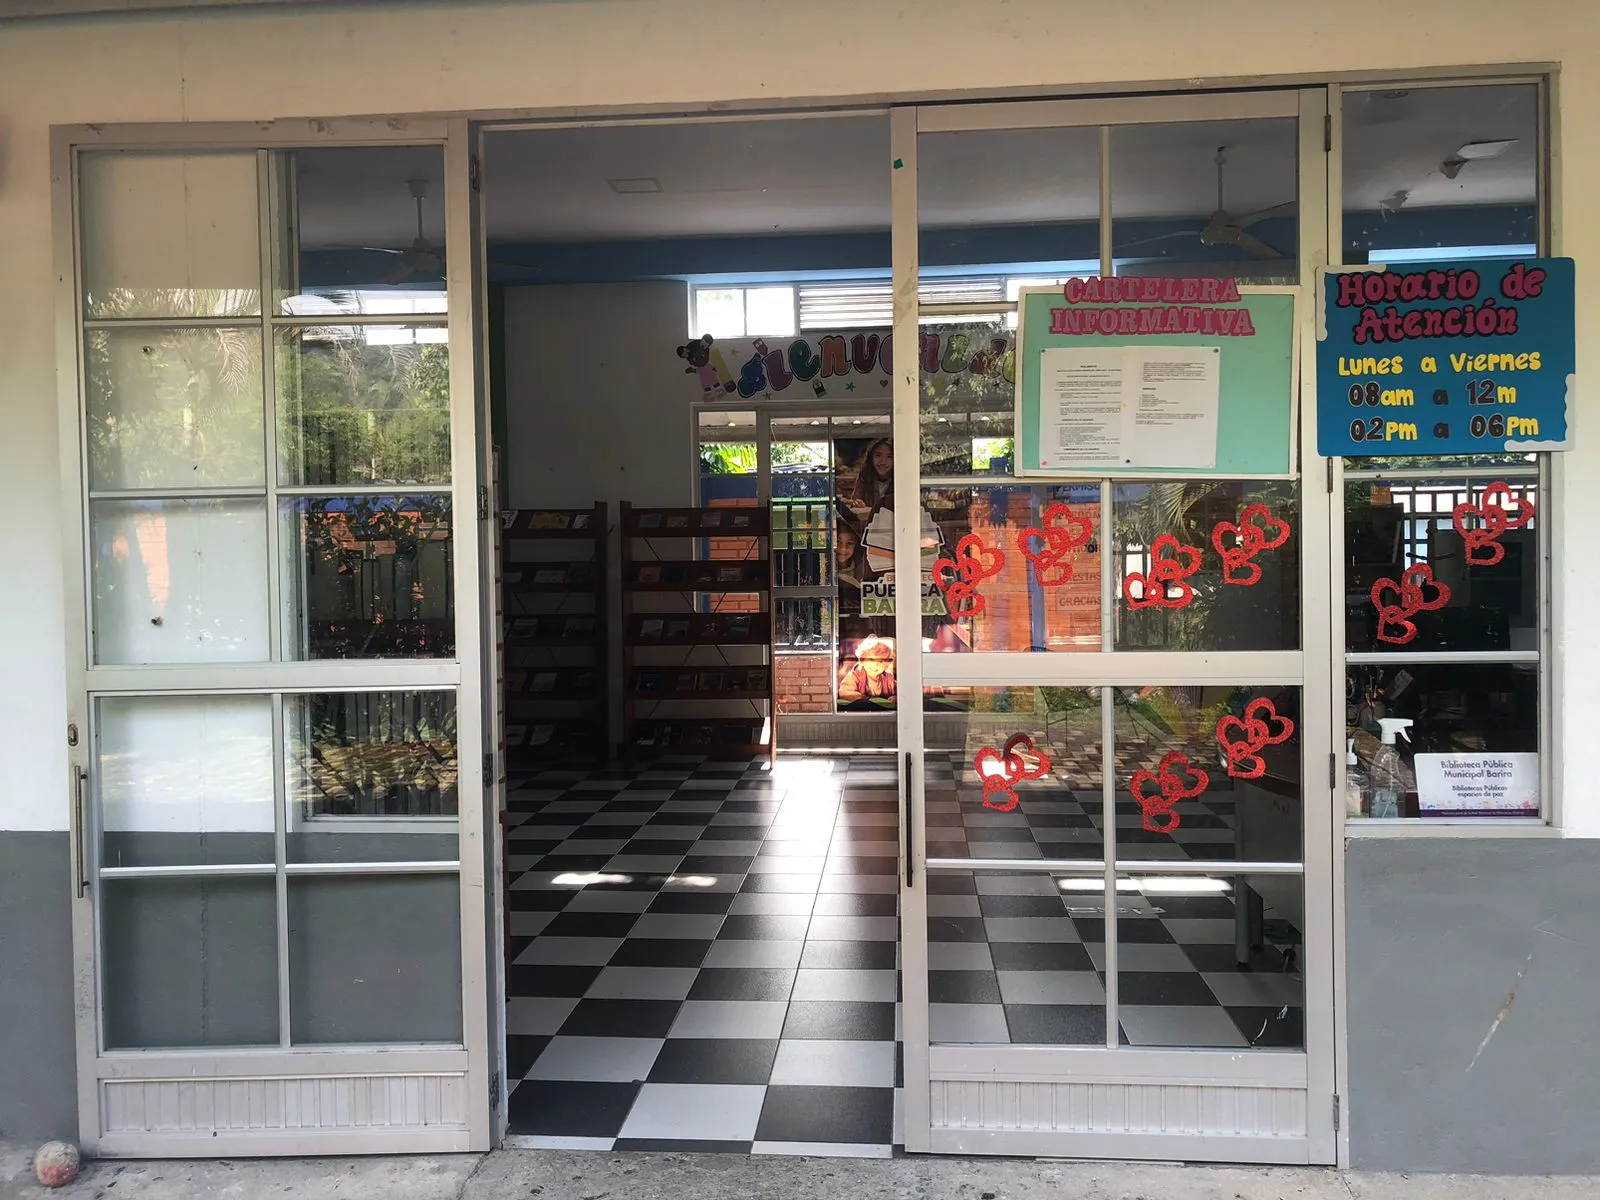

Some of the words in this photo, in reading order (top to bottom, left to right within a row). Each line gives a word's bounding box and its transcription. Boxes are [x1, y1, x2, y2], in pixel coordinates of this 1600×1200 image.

[1063, 276, 1242, 304] CARTELERA
[1336, 269, 1480, 307] Horario
[1501, 263, 1547, 300] de
[1049, 307, 1256, 336] INFORMATIVA
[1354, 298, 1519, 345] Atención
[1338, 355, 1404, 377] Lunes
[1420, 356, 1438, 374] a
[1450, 351, 1542, 373] Viernes
[1347, 380, 1415, 408] 08am
[1432, 388, 1449, 404] a
[1465, 379, 1517, 406] 12m
[1433, 421, 1450, 438] a
[862, 598, 945, 614] BARA
[1440, 760, 1480, 769] Biblioteca
[1483, 760, 1513, 769] Pública
[1443, 770, 1484, 779] Municipal
[1486, 770, 1513, 778] Barira
